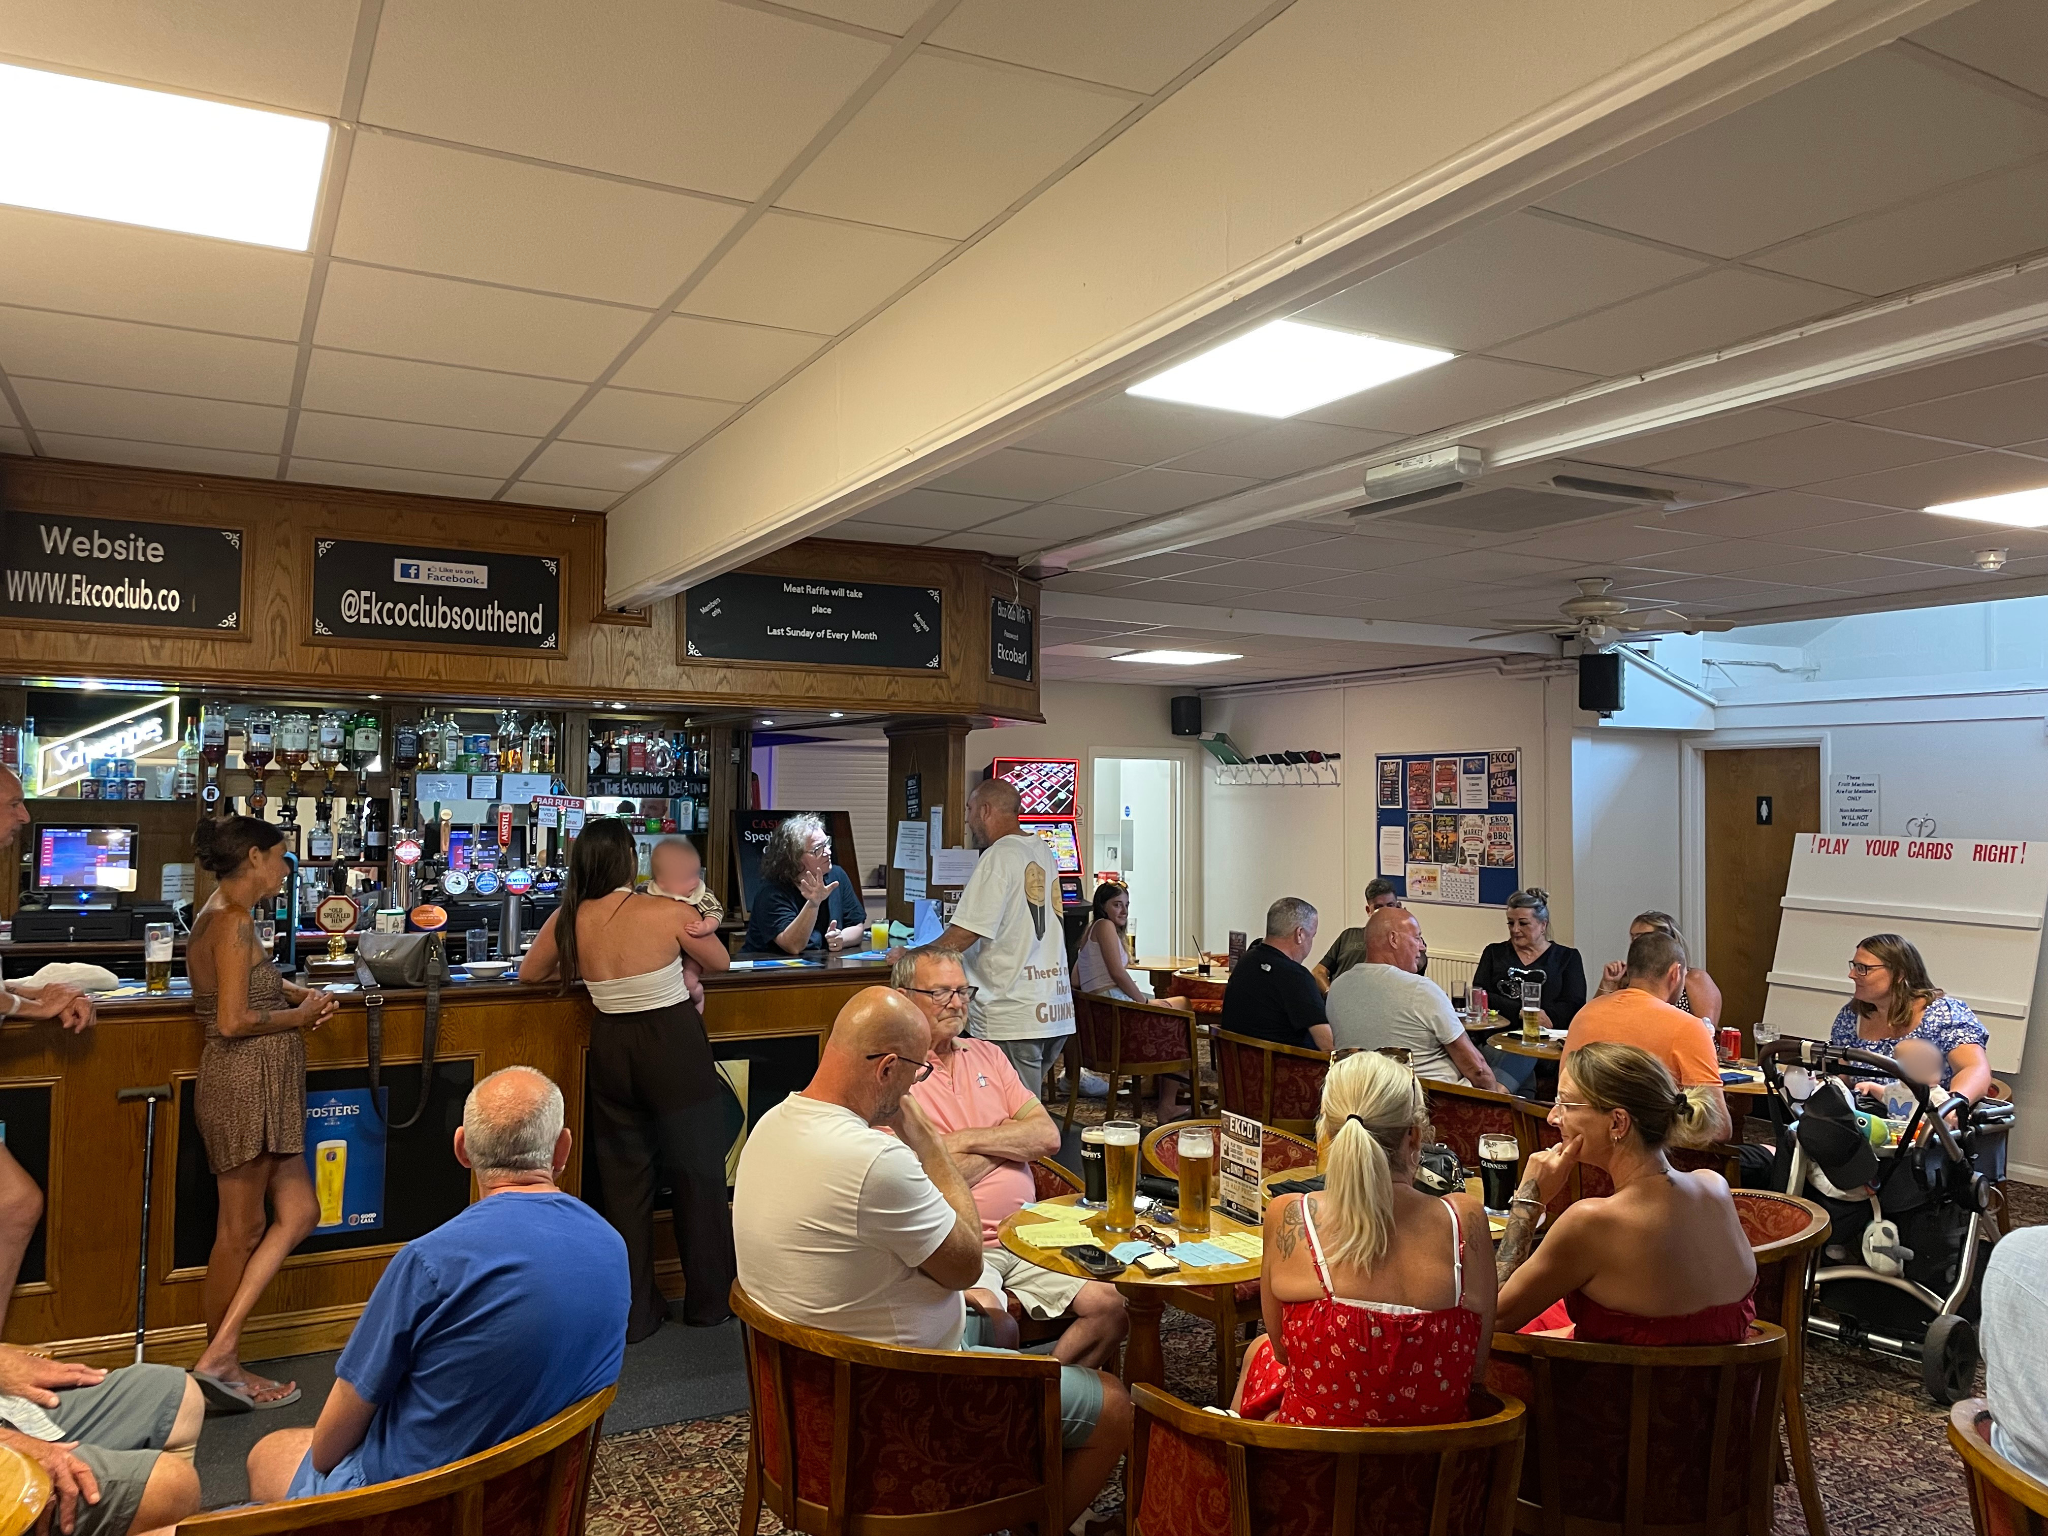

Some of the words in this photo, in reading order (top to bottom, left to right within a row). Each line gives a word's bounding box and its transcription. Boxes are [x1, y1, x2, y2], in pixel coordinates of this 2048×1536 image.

[39, 524, 165, 563] Website
[439, 566, 453, 574] Like
[427, 572, 480, 585] Facebook
[783, 582, 805, 594] Meat
[806, 584, 830, 596] Raffle
[831, 588, 845, 597] will
[846, 589, 863, 598] take
[341, 589, 543, 635] @Ekcoclubsouthend
[811, 604, 832, 615] place
[767, 625, 785, 636] Last
[785, 627, 815, 640] Sunday
[816, 630, 826, 638] of
[826, 629, 849, 642] Every
[851, 630, 878, 640] Month
[1490, 752, 1515, 764] EKCO
[1494, 771, 1509, 779] FREE
[600, 779, 620, 795] THE
[621, 778, 665, 795] EVENING
[1490, 776, 1516, 789] POOL
[536, 797, 554, 806] BAR
[501, 813, 510, 841] AMSTEL
[1463, 828, 1483, 836] MARKET
[1493, 831, 1508, 840] BBQ
[1865, 839, 1900, 858] YOUR
[1907, 840, 1954, 860] CARDS
[1024, 961, 1062, 981] There's
[306, 1104, 360, 1119] FOSTER'S
[1229, 1116, 1253, 1139] EKCO
[1481, 1159, 1508, 1170] GUINNESS
